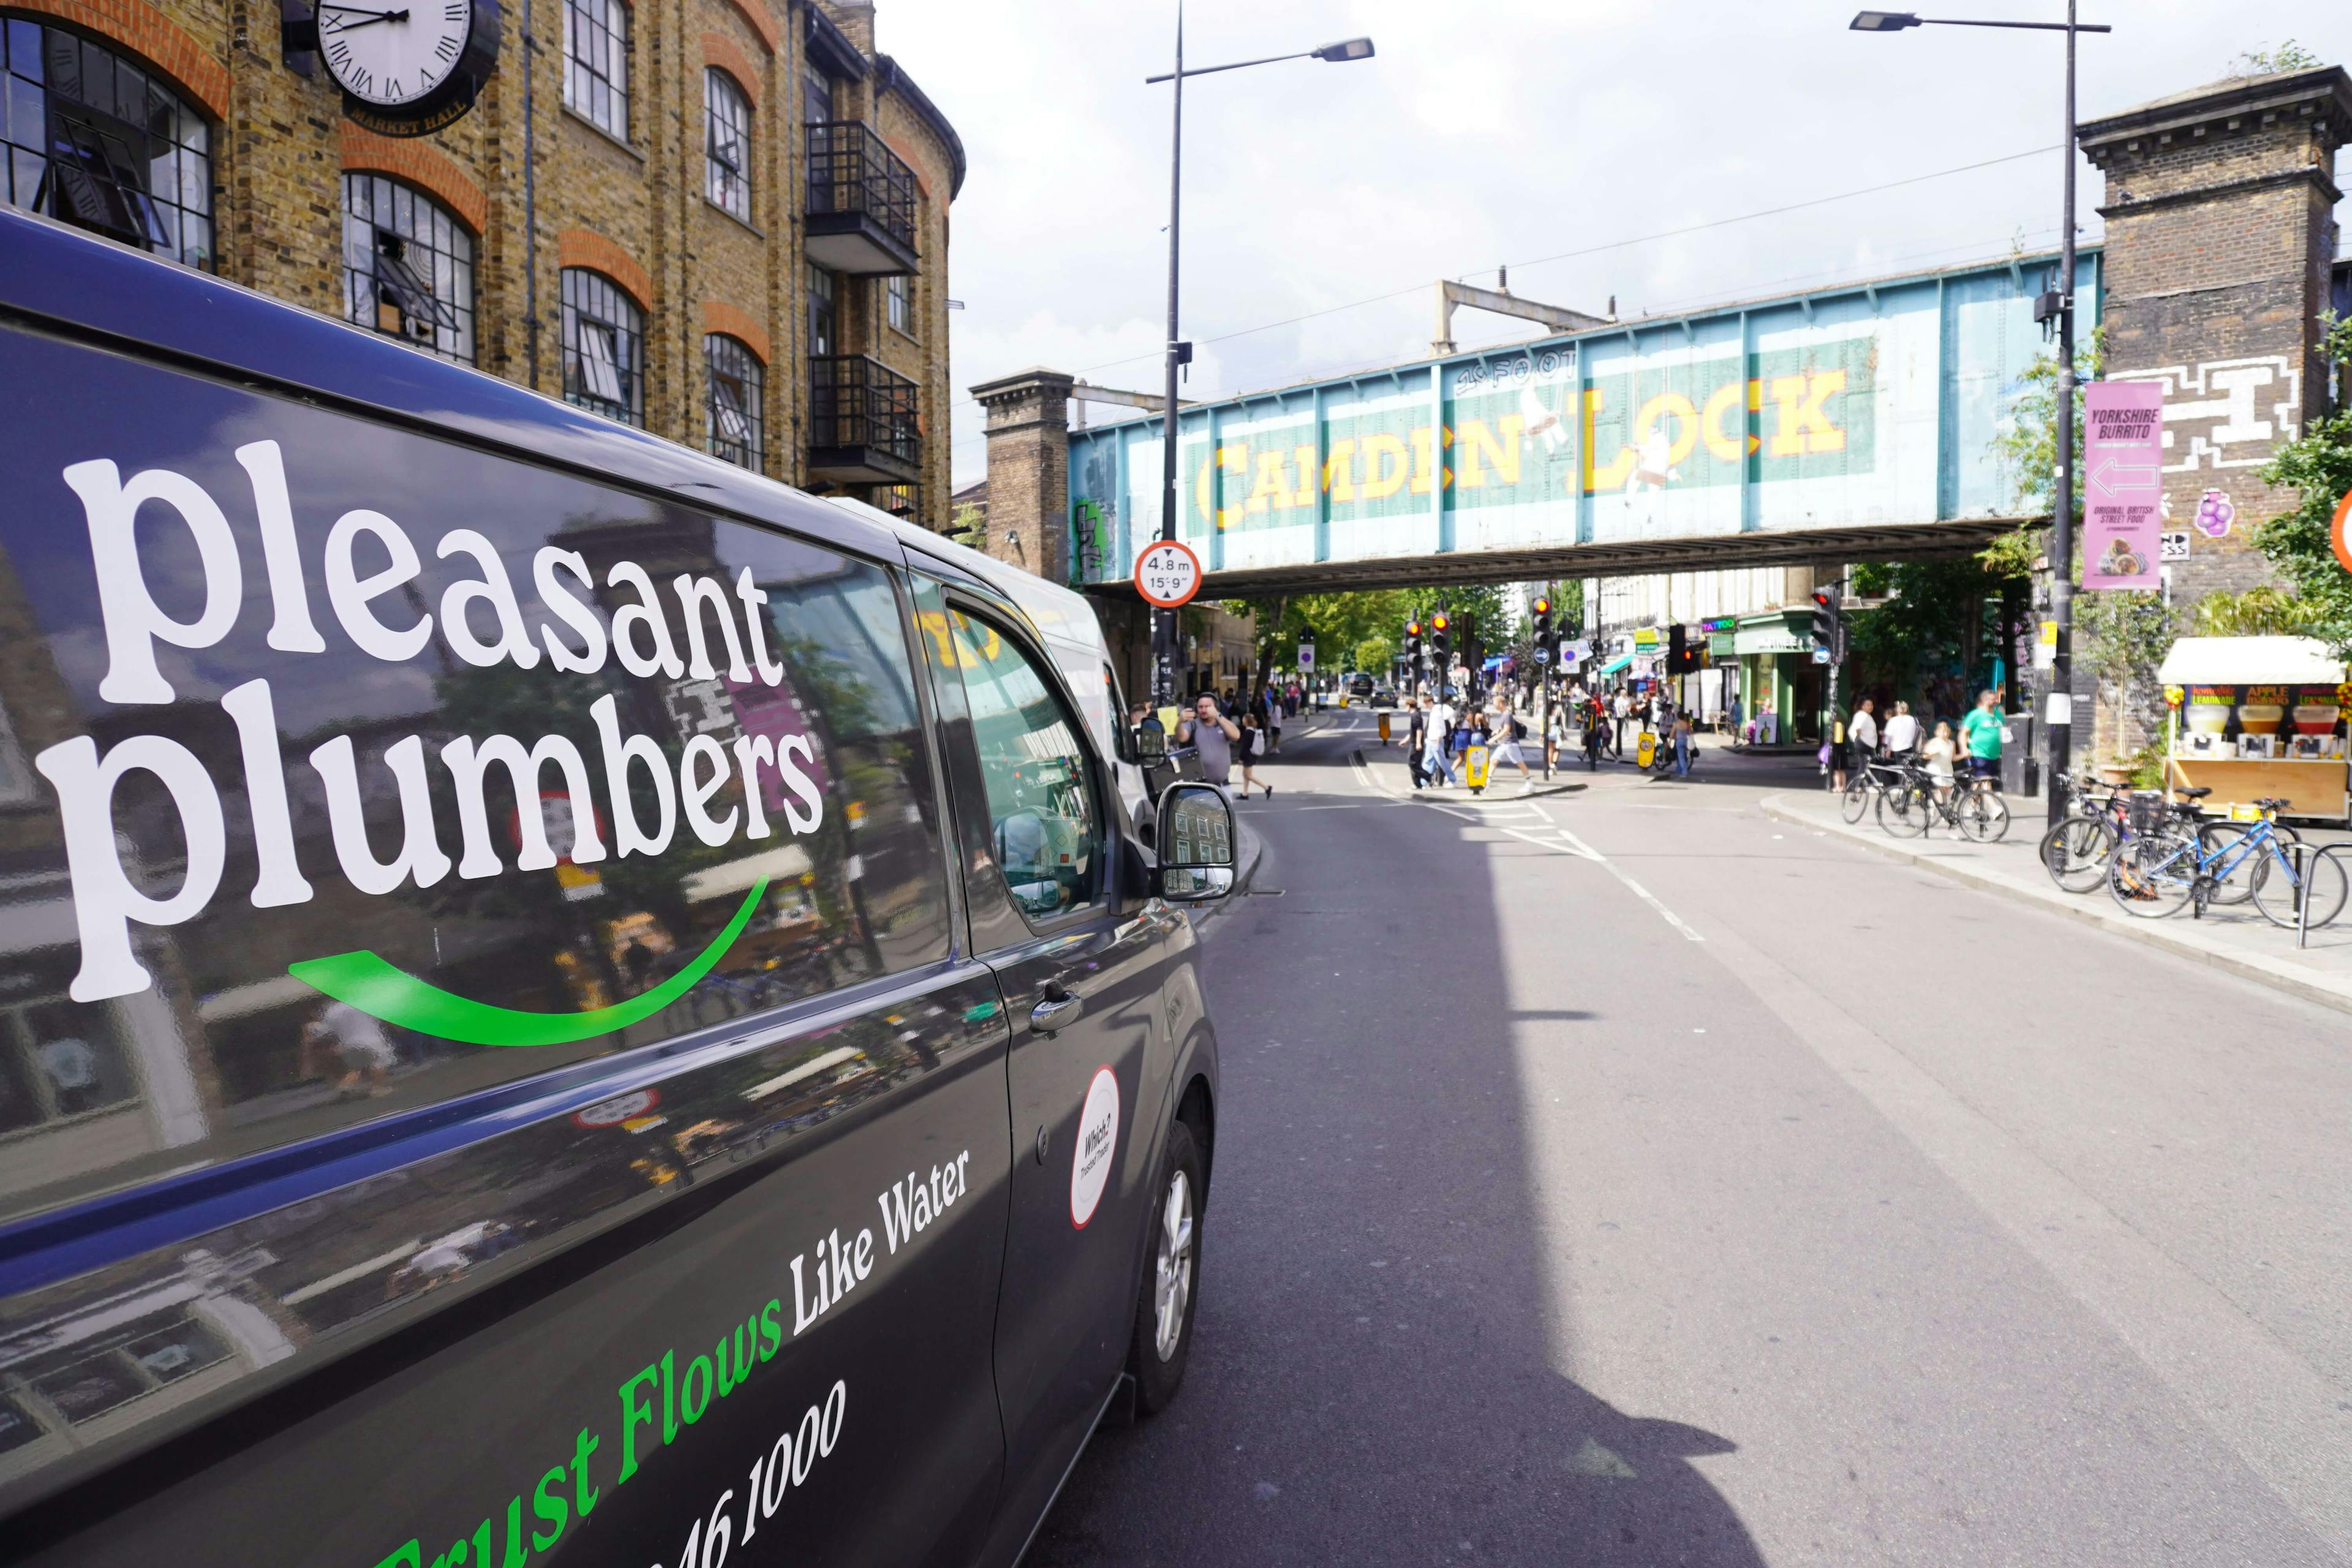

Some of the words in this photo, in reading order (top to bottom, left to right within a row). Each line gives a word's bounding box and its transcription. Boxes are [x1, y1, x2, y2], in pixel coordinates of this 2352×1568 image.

[352, 108, 418, 134] MARKET
[424, 100, 467, 130] HALL
[2092, 409, 2159, 424] YORKSHIRE
[2098, 424, 2150, 439] BURRITO
[1196, 413, 1525, 530] CAMDEN
[1567, 368, 1847, 494] LOCK
[2094, 506, 2124, 514] ORIGINAL
[2127, 506, 2155, 514] BRITISH
[2100, 515, 2125, 524] STREET
[63, 440, 783, 704] pleasant
[1147, 557, 1174, 570] 4.8
[1178, 562, 1189, 571] m
[1702, 618, 1735, 631] TATTOO
[2192, 695, 2236, 705] LEMONADE
[36, 678, 823, 1003] plumbers
[1085, 1113, 1110, 1159] Which?
[1080, 1156, 1096, 1180] Trusted
[617, 1299, 781, 1485] Flows
[790, 1227, 874, 1336] Like
[878, 1150, 970, 1256] Water
[741, 1380, 846, 1547] 1000
